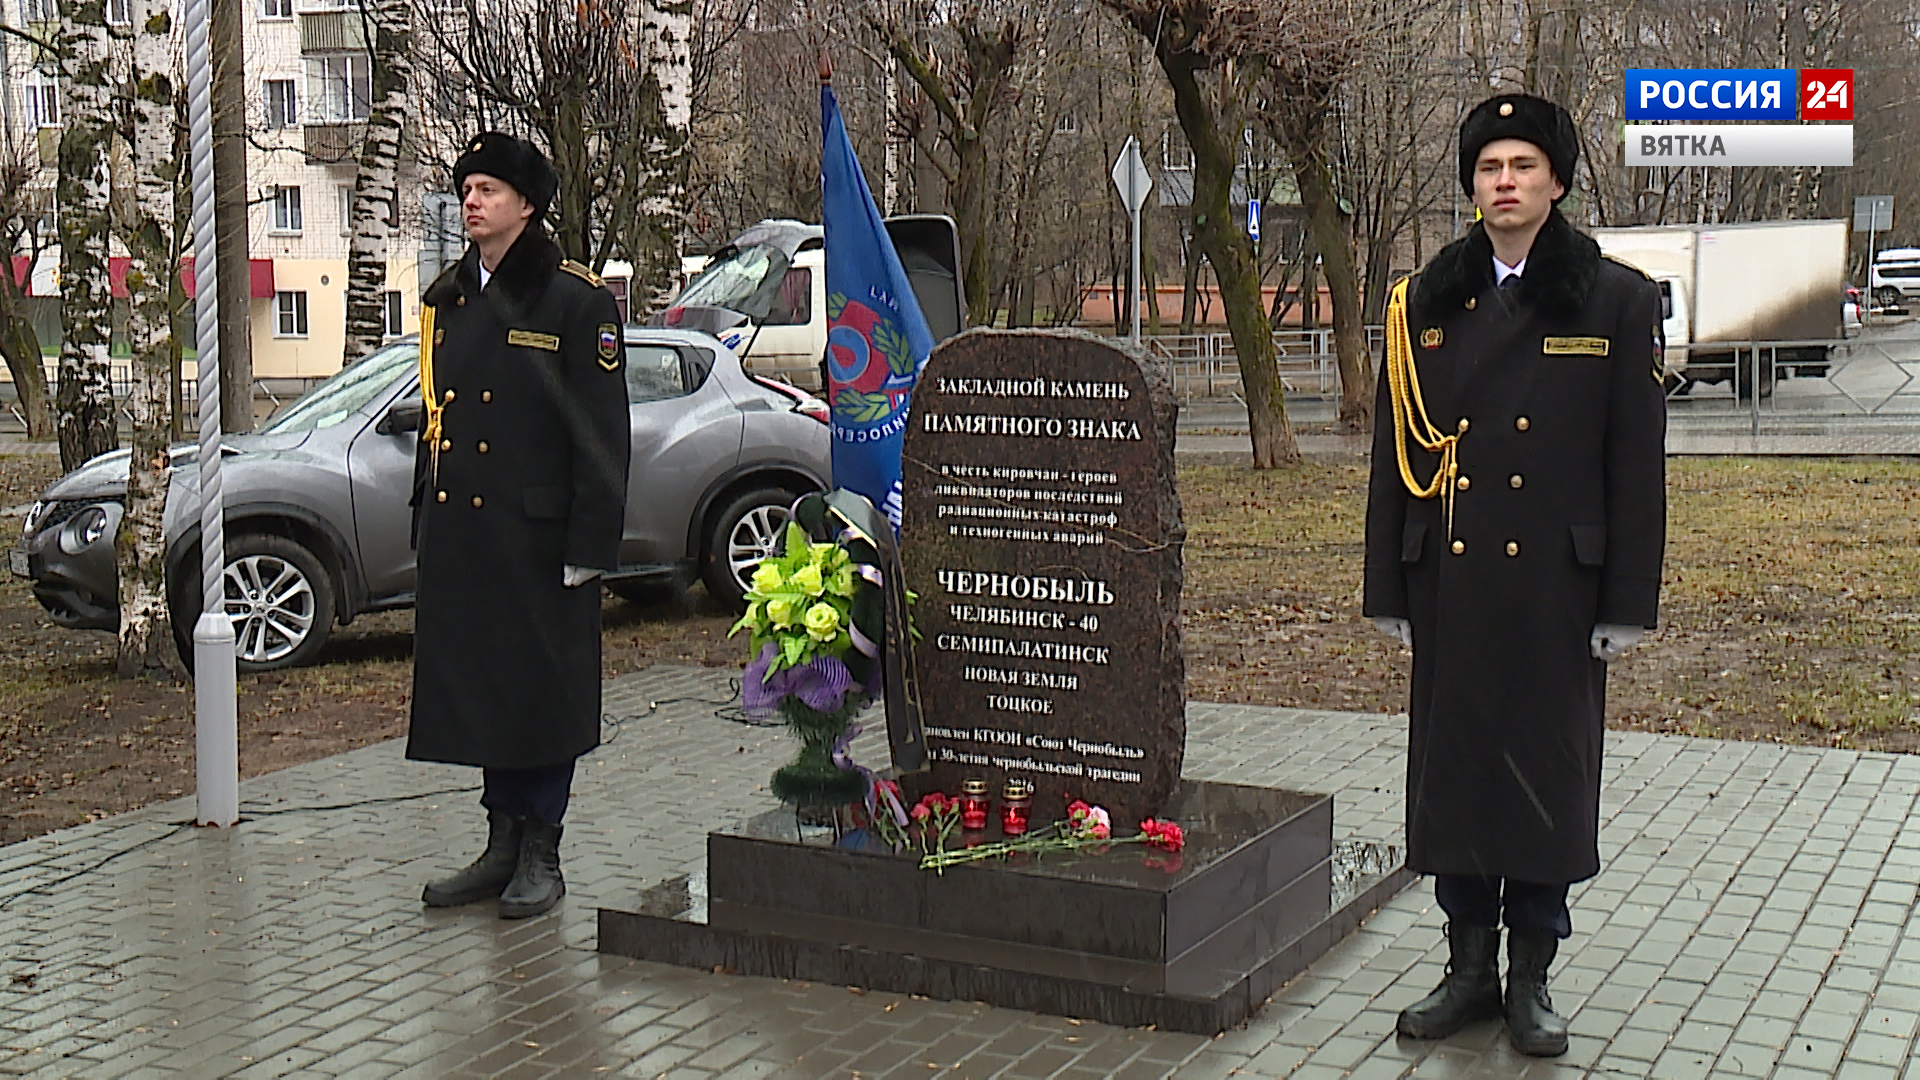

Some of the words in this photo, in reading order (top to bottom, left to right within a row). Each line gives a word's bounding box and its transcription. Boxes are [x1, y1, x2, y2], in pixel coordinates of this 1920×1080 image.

[936, 377, 1045, 398] ЗАКЛАДНОЙ
[1051, 381, 1130, 400] КАМЕНЬ
[924, 414, 1062, 437] ПАМЯТНОГО
[1067, 420, 1142, 440] ЗНАКА
[941, 465, 949, 475] в
[952, 465, 990, 478] честь
[993, 467, 1059, 483] кировчан
[1071, 471, 1118, 485] героев
[934, 483, 1031, 501] ликвидаторов
[1034, 489, 1123, 505] последствий
[938, 504, 1039, 521] радиационных
[1043, 510, 1118, 528] катастроф
[949, 525, 958, 535] и
[962, 525, 1049, 541] техногенных
[1053, 531, 1104, 547] аварий
[937, 569, 1115, 605] ЧЕРНОБЫЛЬ
[950, 605, 1065, 630] ЧЕЛЯБИНСК
[1079, 614, 1098, 632] 40
[937, 634, 1110, 664] СЕМИПАЛАТИНСК
[964, 666, 1018, 685] НОВАЯ
[1022, 671, 1078, 691] ЗЕМЛЯ
[986, 694, 1054, 715] ТОЦКОЕ
[924, 726, 970, 741] ановлен
